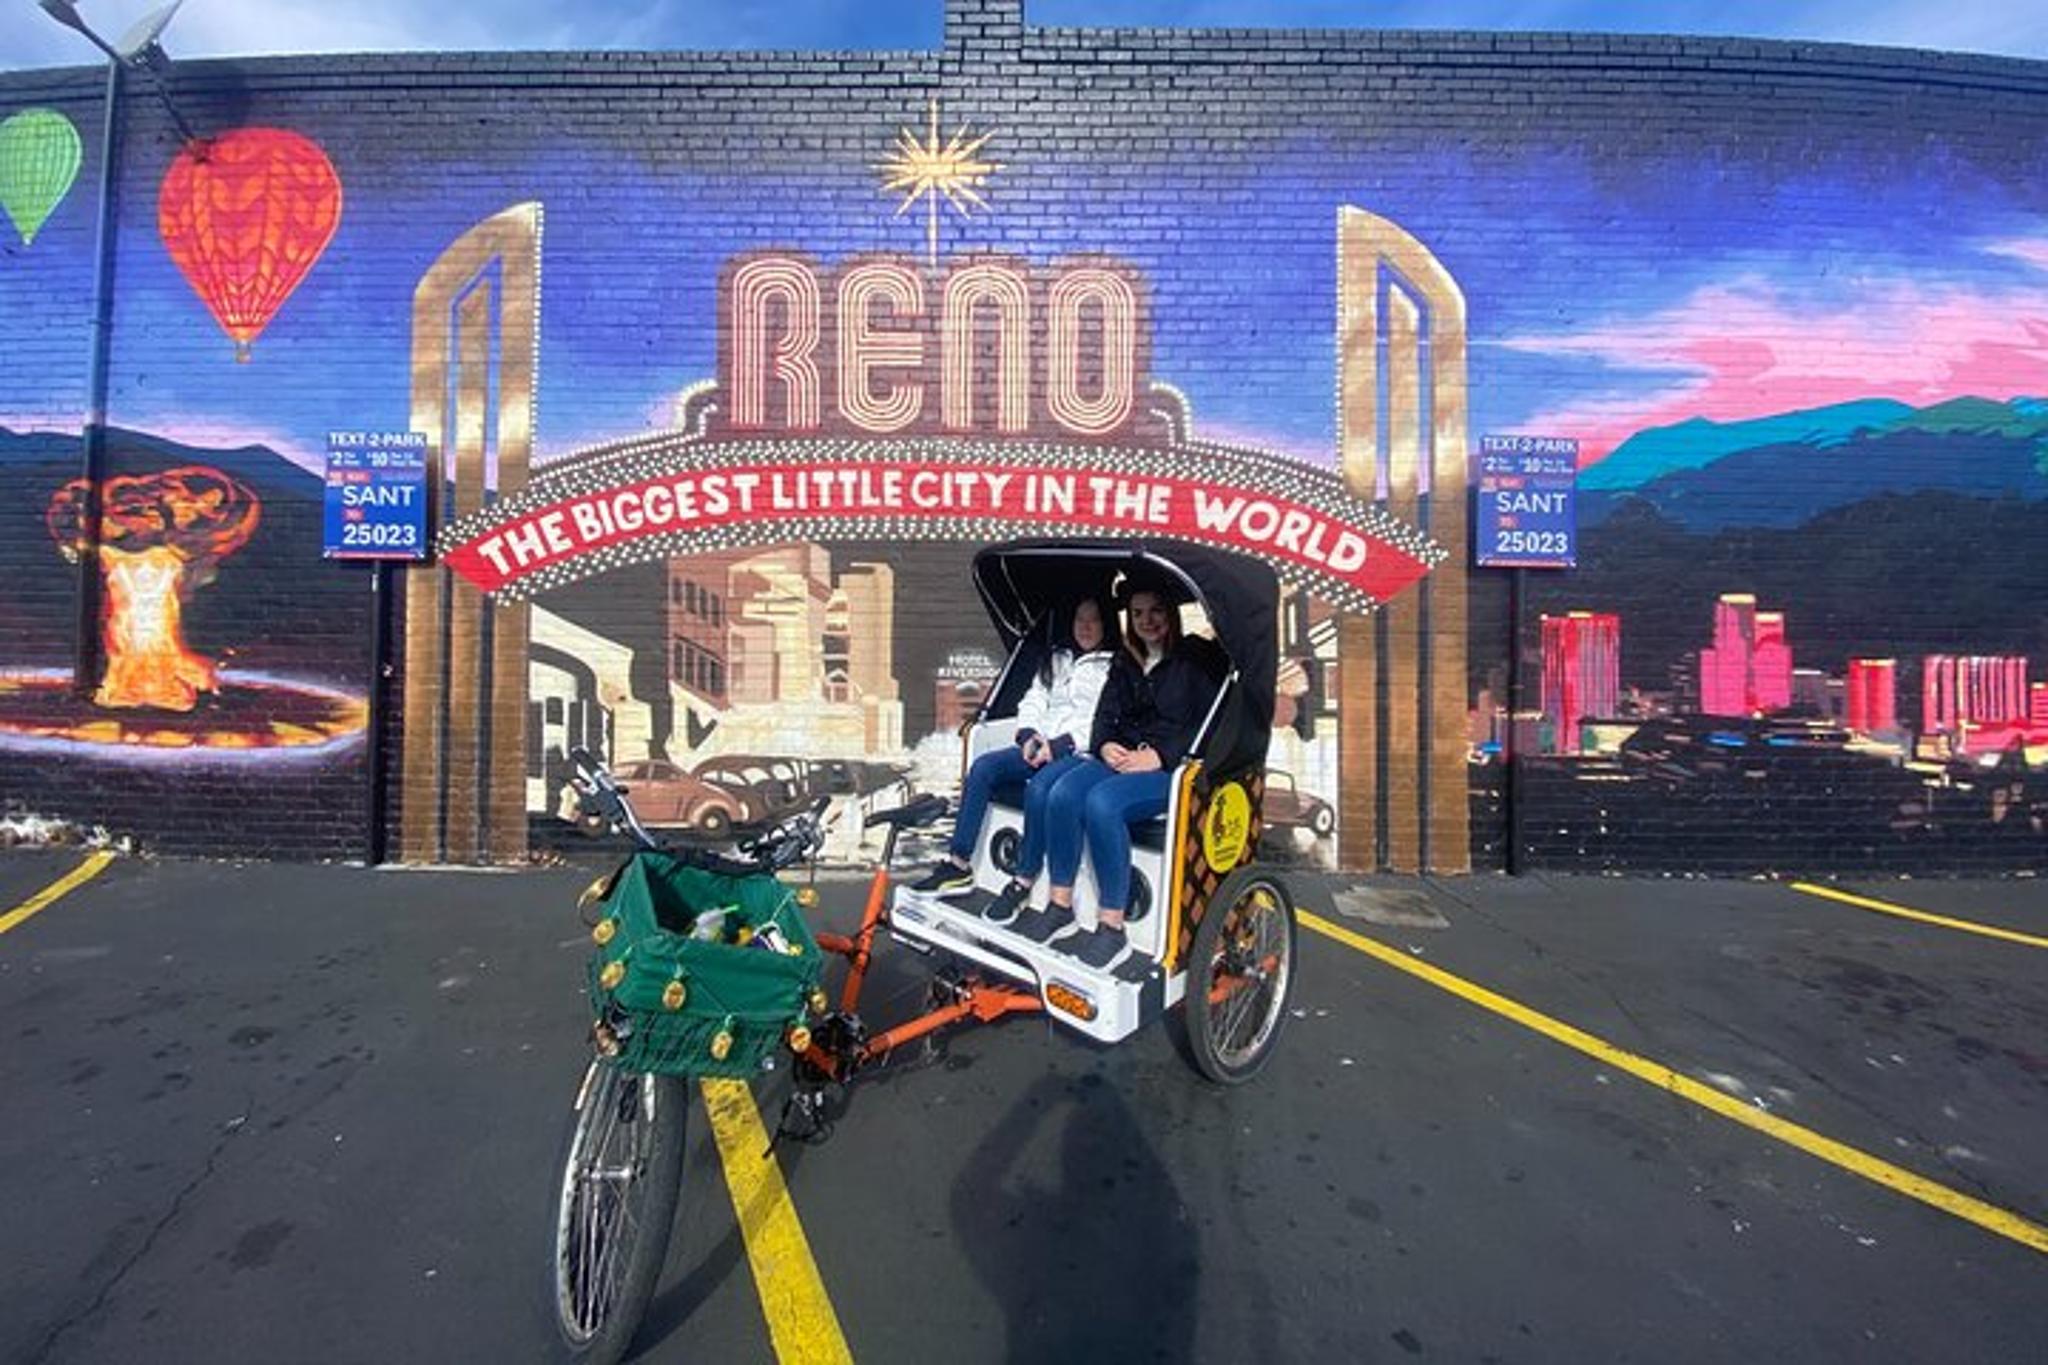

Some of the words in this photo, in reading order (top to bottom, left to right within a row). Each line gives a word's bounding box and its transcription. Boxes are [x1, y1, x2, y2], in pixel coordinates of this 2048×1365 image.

[731, 257, 1135, 434] RENO
[329, 431, 425, 447] TEXT-2-PARK
[1483, 437, 1576, 452] TEXT-2-PARK
[343, 485, 415, 507] SANT
[1497, 491, 1567, 513] SANT
[478, 511, 574, 576] THE
[571, 473, 760, 541] BIGGEST
[773, 470, 902, 511] LITTLE
[911, 470, 1012, 509] CITY
[1025, 474, 1080, 514] IN
[1089, 477, 1171, 524] THE
[1194, 489, 1368, 573] WORLD
[343, 523, 416, 546] 25023
[1497, 531, 1568, 554] 25023
